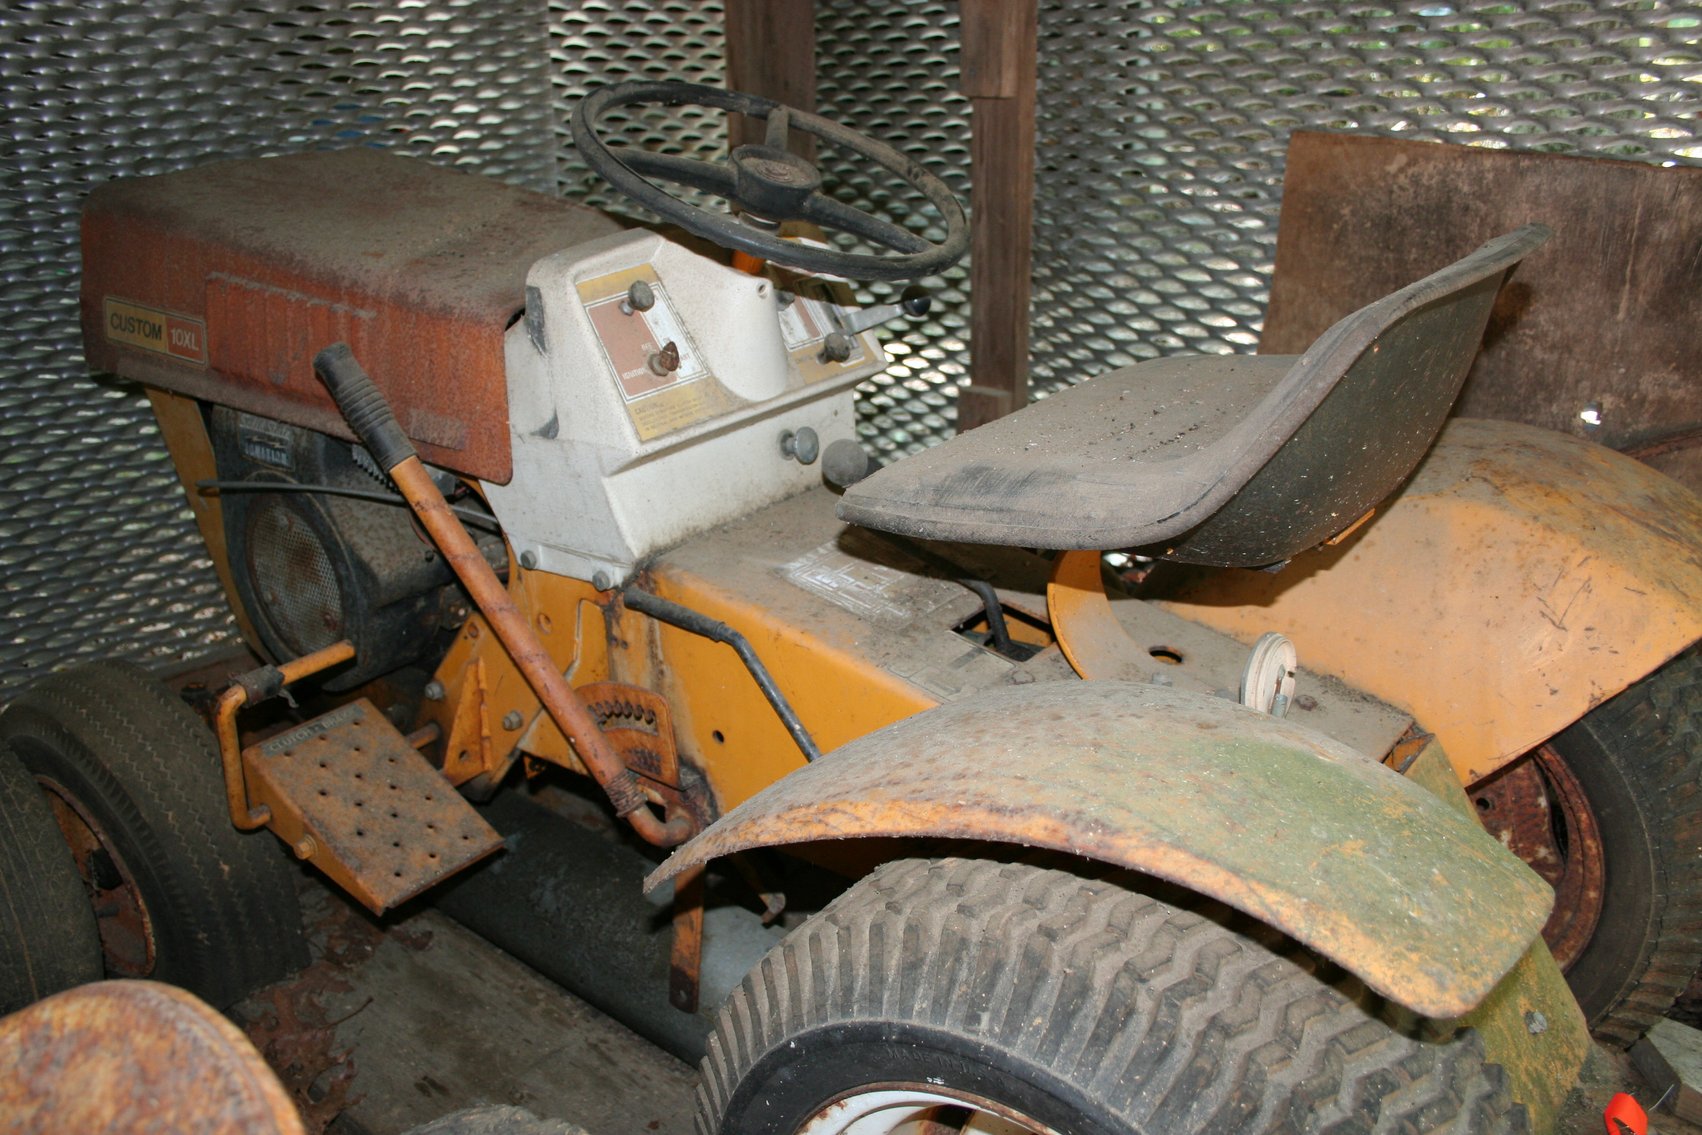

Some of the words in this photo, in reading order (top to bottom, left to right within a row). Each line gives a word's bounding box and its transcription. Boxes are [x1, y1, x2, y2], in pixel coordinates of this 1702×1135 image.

[110, 312, 162, 340] CUSTOM
[170, 327, 200, 352] 10XL
[270, 726, 314, 752] CLUTCH
